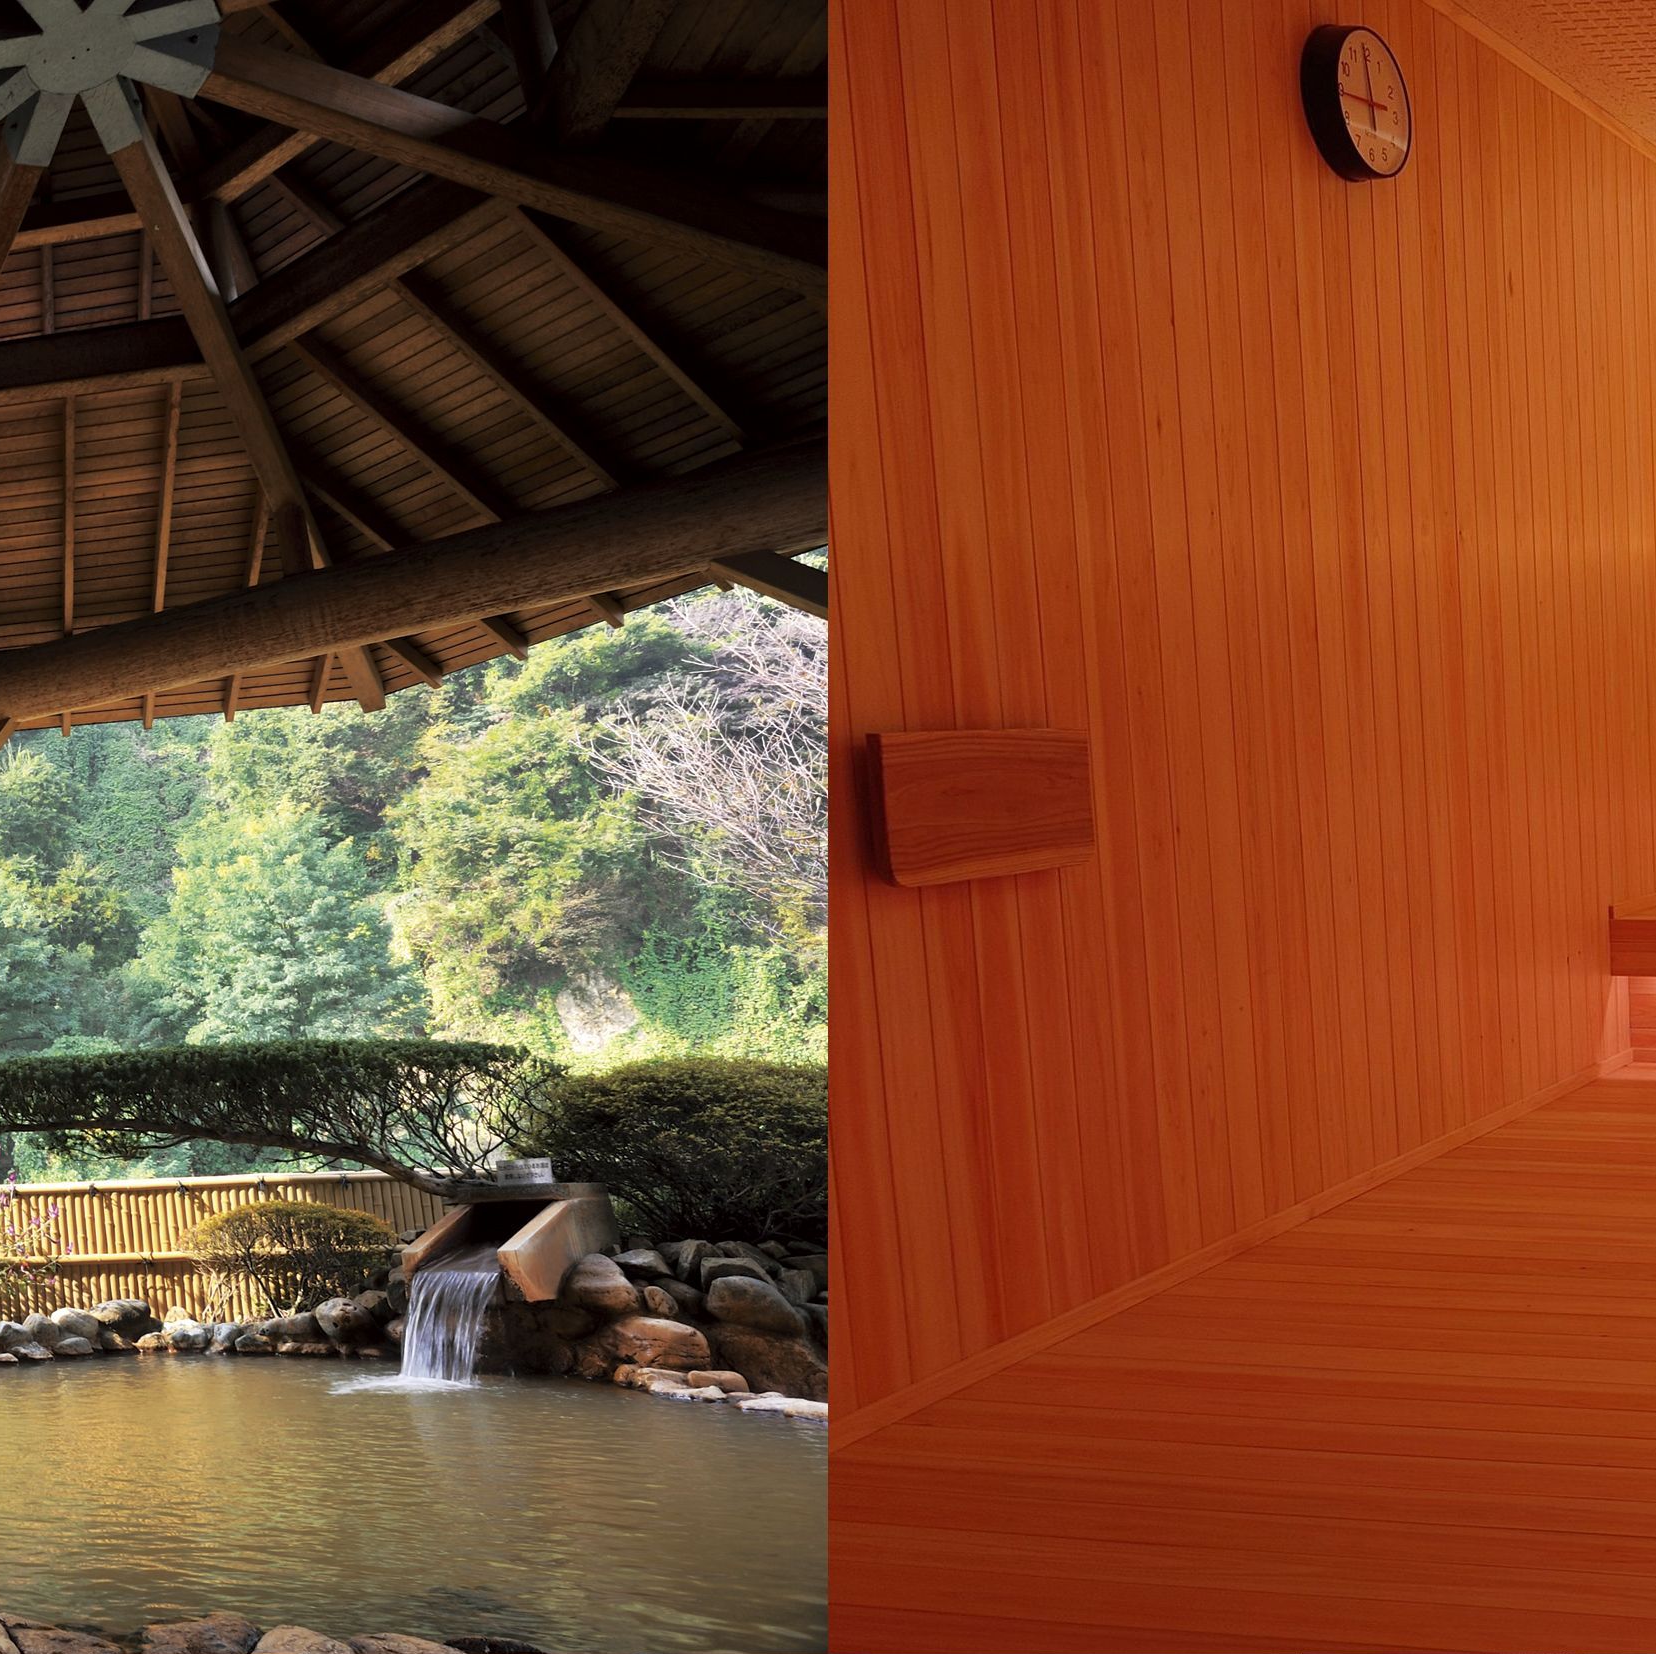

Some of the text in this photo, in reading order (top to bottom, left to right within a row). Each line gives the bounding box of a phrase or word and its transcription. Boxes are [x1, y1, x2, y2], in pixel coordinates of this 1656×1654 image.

[1348, 46, 1358, 63] 11
[1341, 61, 1350, 77] 10
[1376, 61, 1381, 73] 1
[1388, 85, 1394, 100] 2
[1393, 111, 1399, 126] 3
[1355, 134, 1362, 148] 7
[1369, 147, 1375, 162] 6
[1381, 147, 1388, 162] 5
